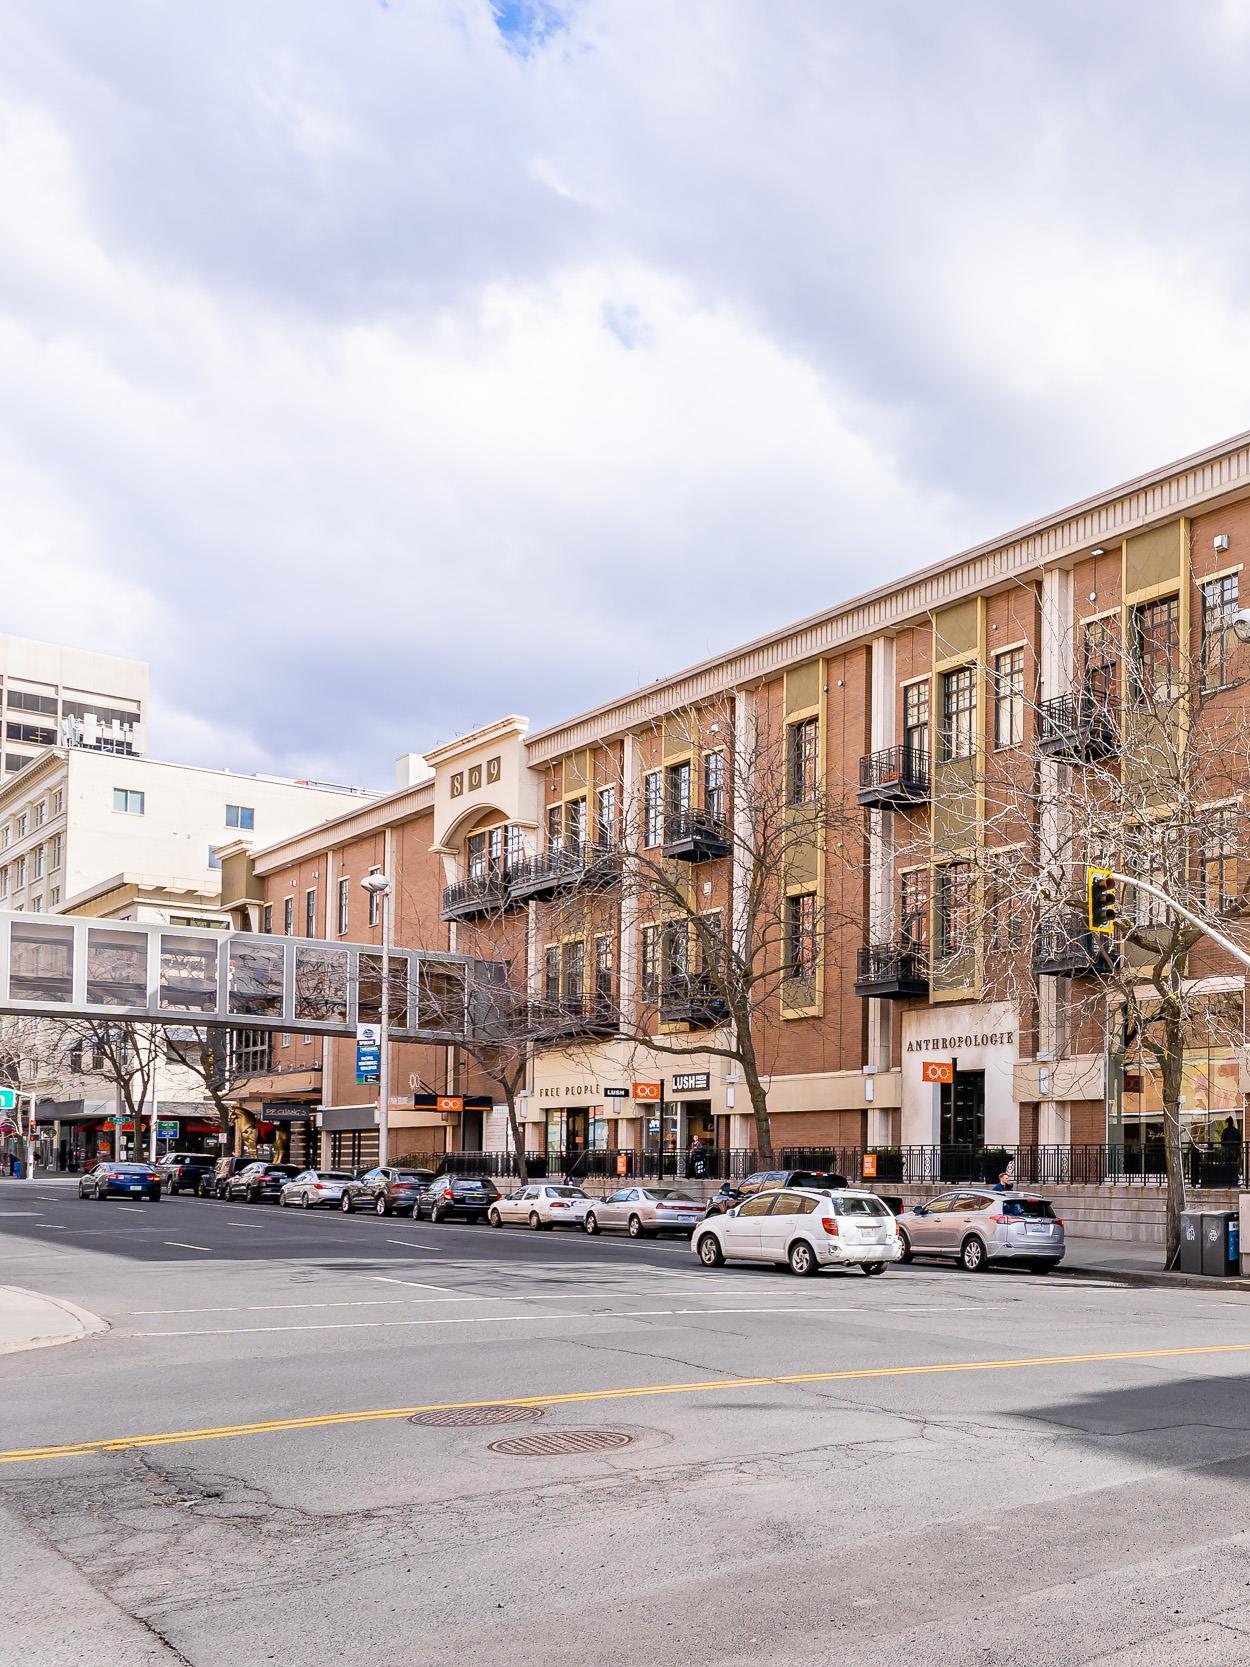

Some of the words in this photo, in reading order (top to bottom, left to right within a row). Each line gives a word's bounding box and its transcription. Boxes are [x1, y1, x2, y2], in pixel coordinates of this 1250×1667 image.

[454, 760, 498, 795] 809
[907, 1031, 1014, 1052] ANTHROPOLOGIE
[540, 1087, 560, 1097] FREE
[565, 1084, 600, 1096] PEOPLE
[673, 1075, 695, 1090] LUSH
